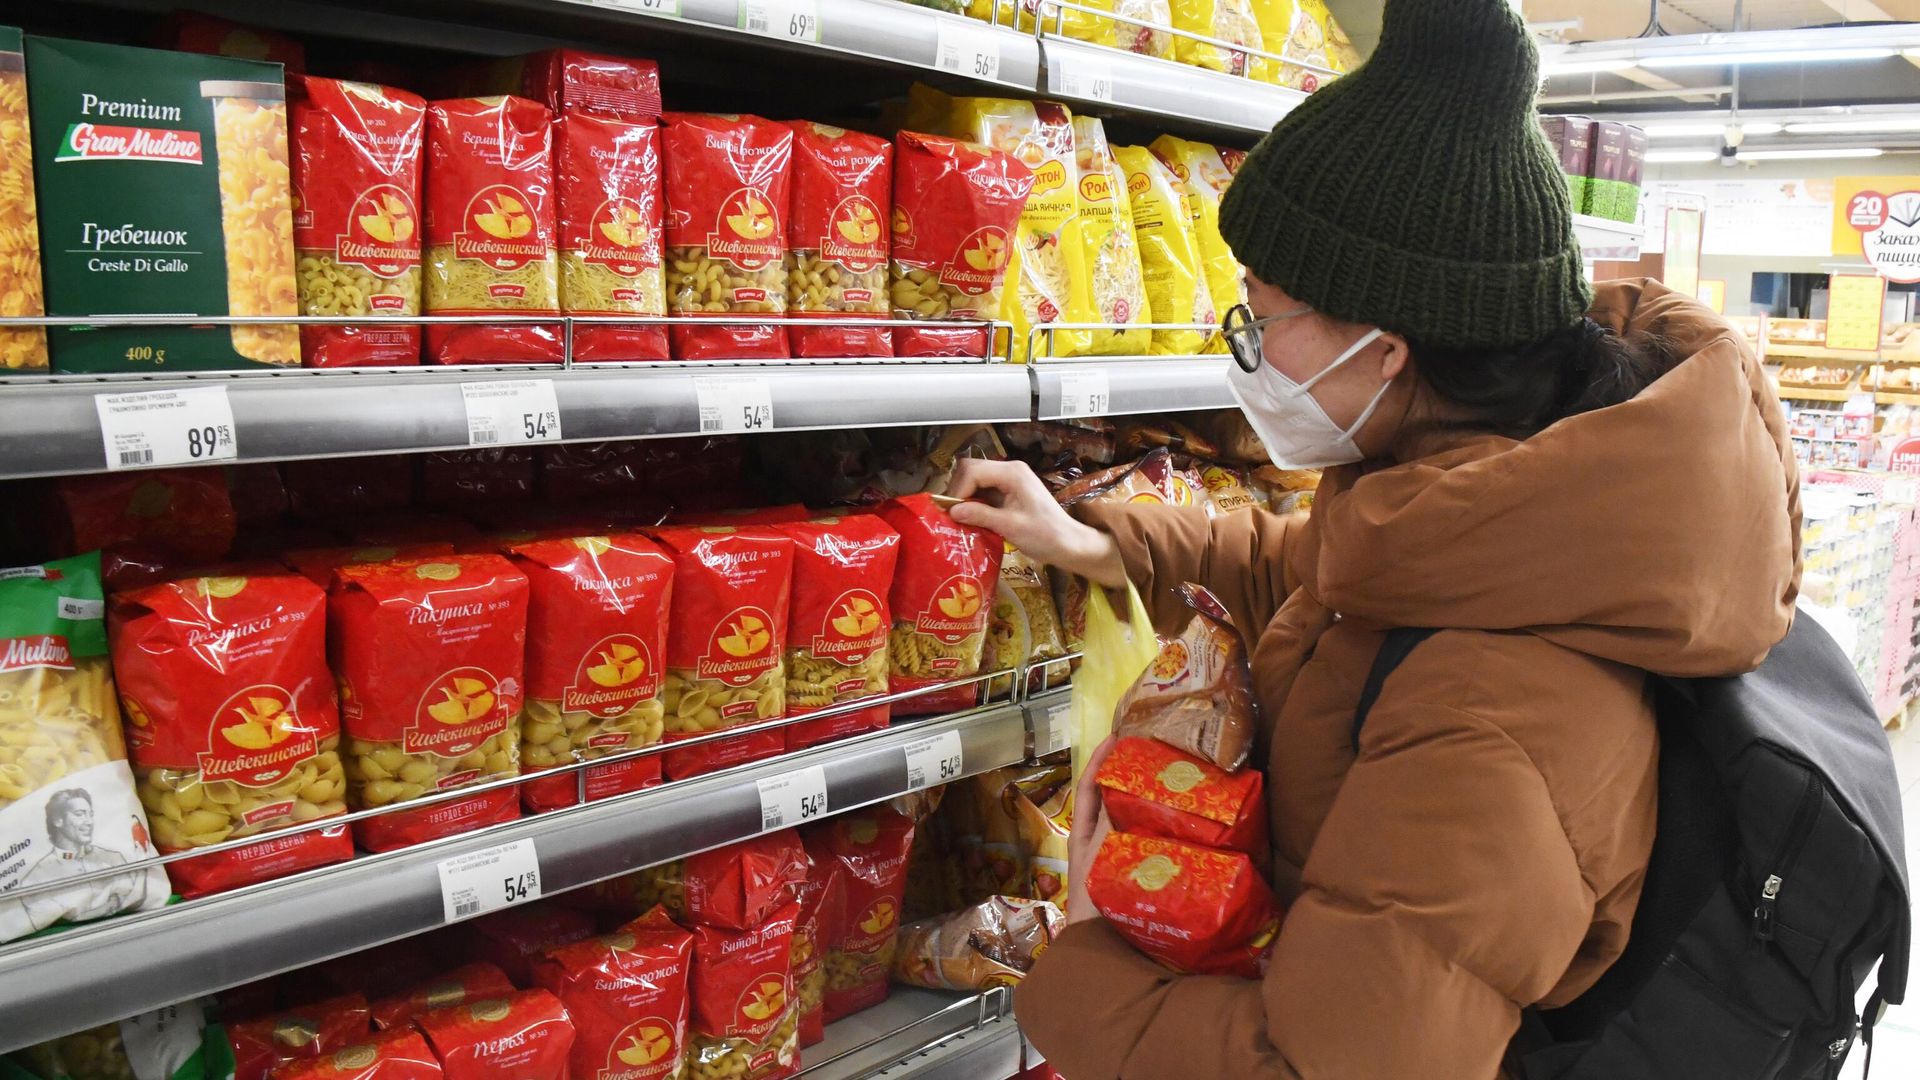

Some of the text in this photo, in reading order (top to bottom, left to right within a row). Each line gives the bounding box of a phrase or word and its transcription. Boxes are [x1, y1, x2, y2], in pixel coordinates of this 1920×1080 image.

[789, 13, 807, 37] 69
[974, 53, 989, 76] 56
[1092, 80, 1105, 99] 49
[82, 93, 181, 121] Premium
[70, 122, 200, 157] Gran Mulino
[1080, 207, 1113, 217] ЛАПША
[1853, 196, 1882, 215] 20
[82, 222, 187, 251] Гребешок
[458, 238, 545, 255] Шебекинские
[88, 258, 189, 272] Creste Di Gallo
[125, 346, 165, 364] 400 g
[1089, 394, 1100, 413] 51
[523, 411, 556, 439] 54 95
[744, 405, 762, 429] 54
[188, 424, 230, 458] 89 95
[645, 573, 658, 581] 393
[290, 611, 306, 622] 393
[409, 601, 484, 627] Ракушка
[2, 636, 70, 668] Mulino
[701, 656, 777, 675] Шебекинские
[568, 682, 654, 707] Шебекинские
[408, 715, 505, 748] Шебекинские
[203, 738, 313, 776] Шебекинские
[940, 757, 954, 779] 54
[586, 763, 610, 777] ЕРДОЕ
[429, 799, 489, 824] ТВЕРДОЕ ЗЕРНО
[801, 794, 818, 819] 54
[236, 834, 306, 862] ТВЕРДОЕ ЗЕРНО
[504, 870, 536, 902] 54 95
[720, 921, 793, 955] Витой рожок
